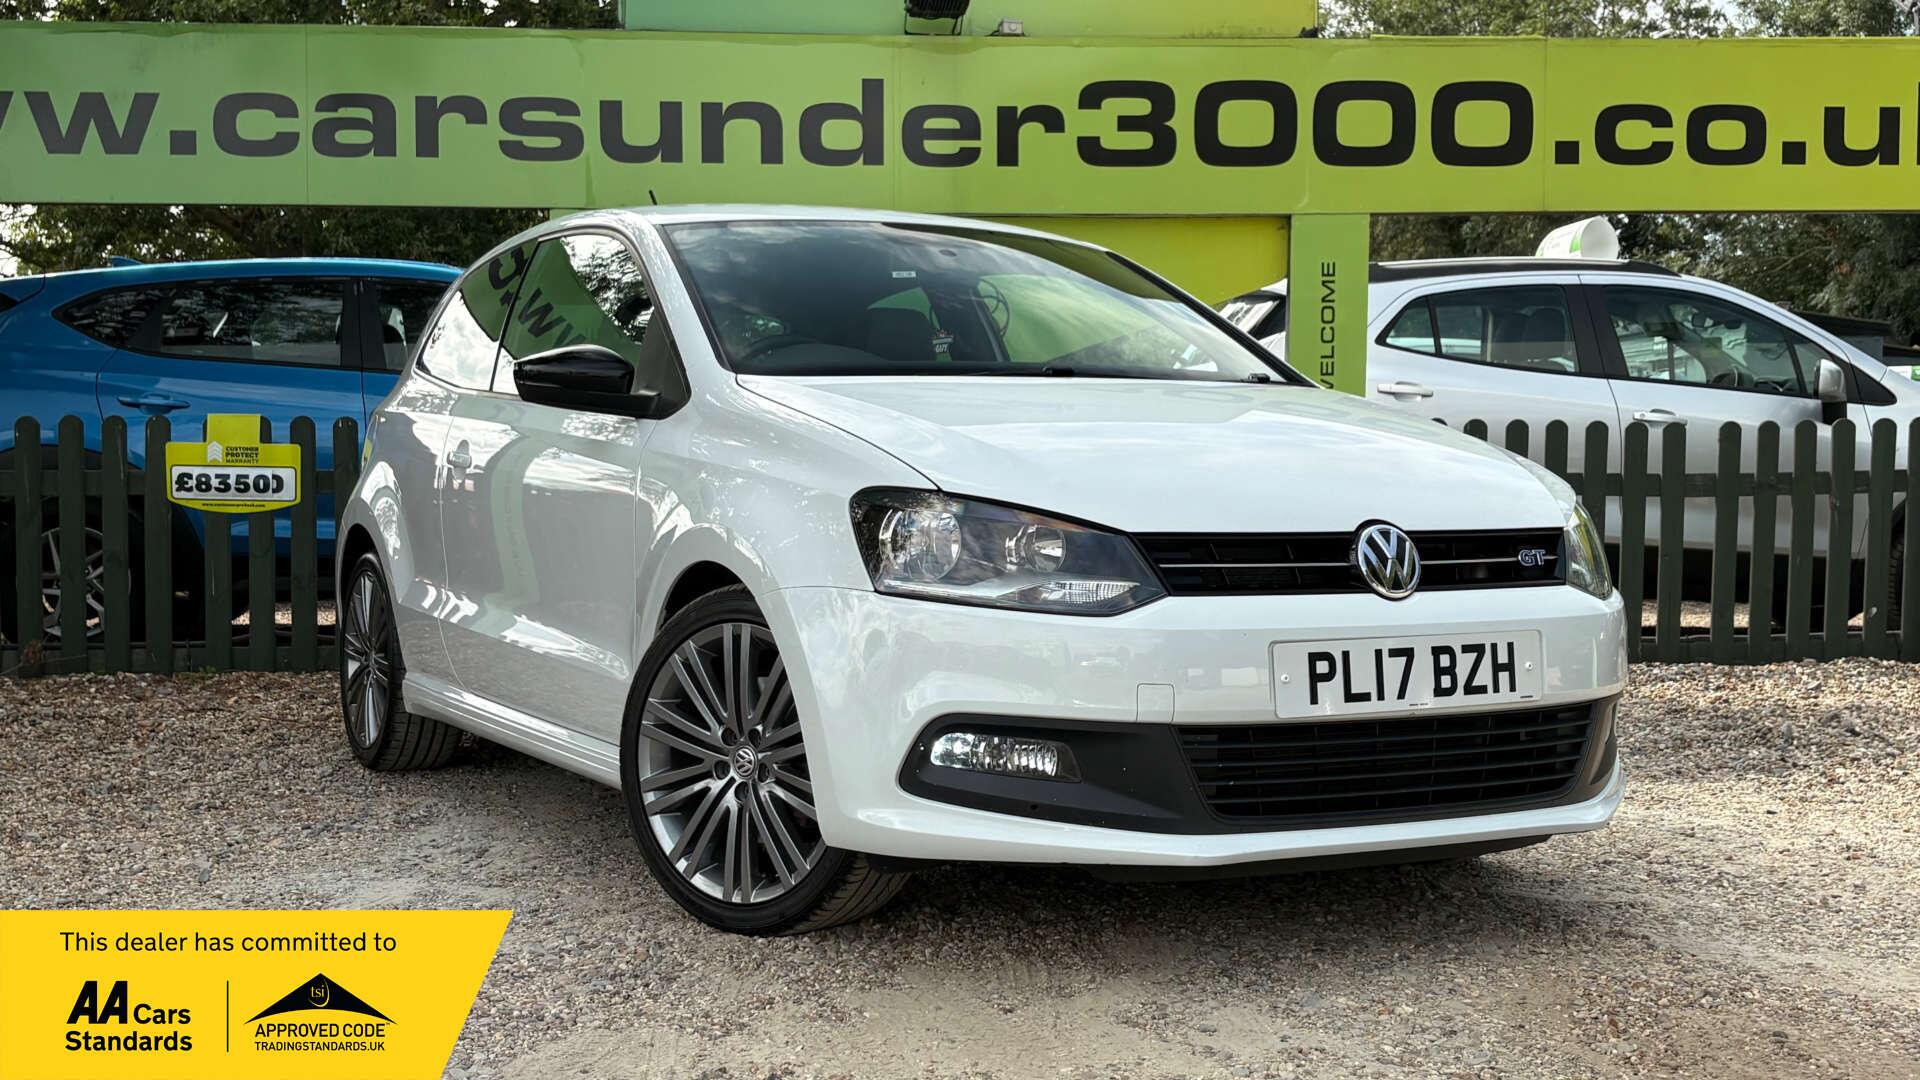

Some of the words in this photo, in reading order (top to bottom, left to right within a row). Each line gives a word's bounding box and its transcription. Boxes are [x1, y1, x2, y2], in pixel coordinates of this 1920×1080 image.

[0, 79, 1920, 167] w.carsunder3000.co.u
[1518, 549, 1546, 566] GT
[1308, 647, 1415, 705] PL17
[1431, 641, 1517, 698] BZH
